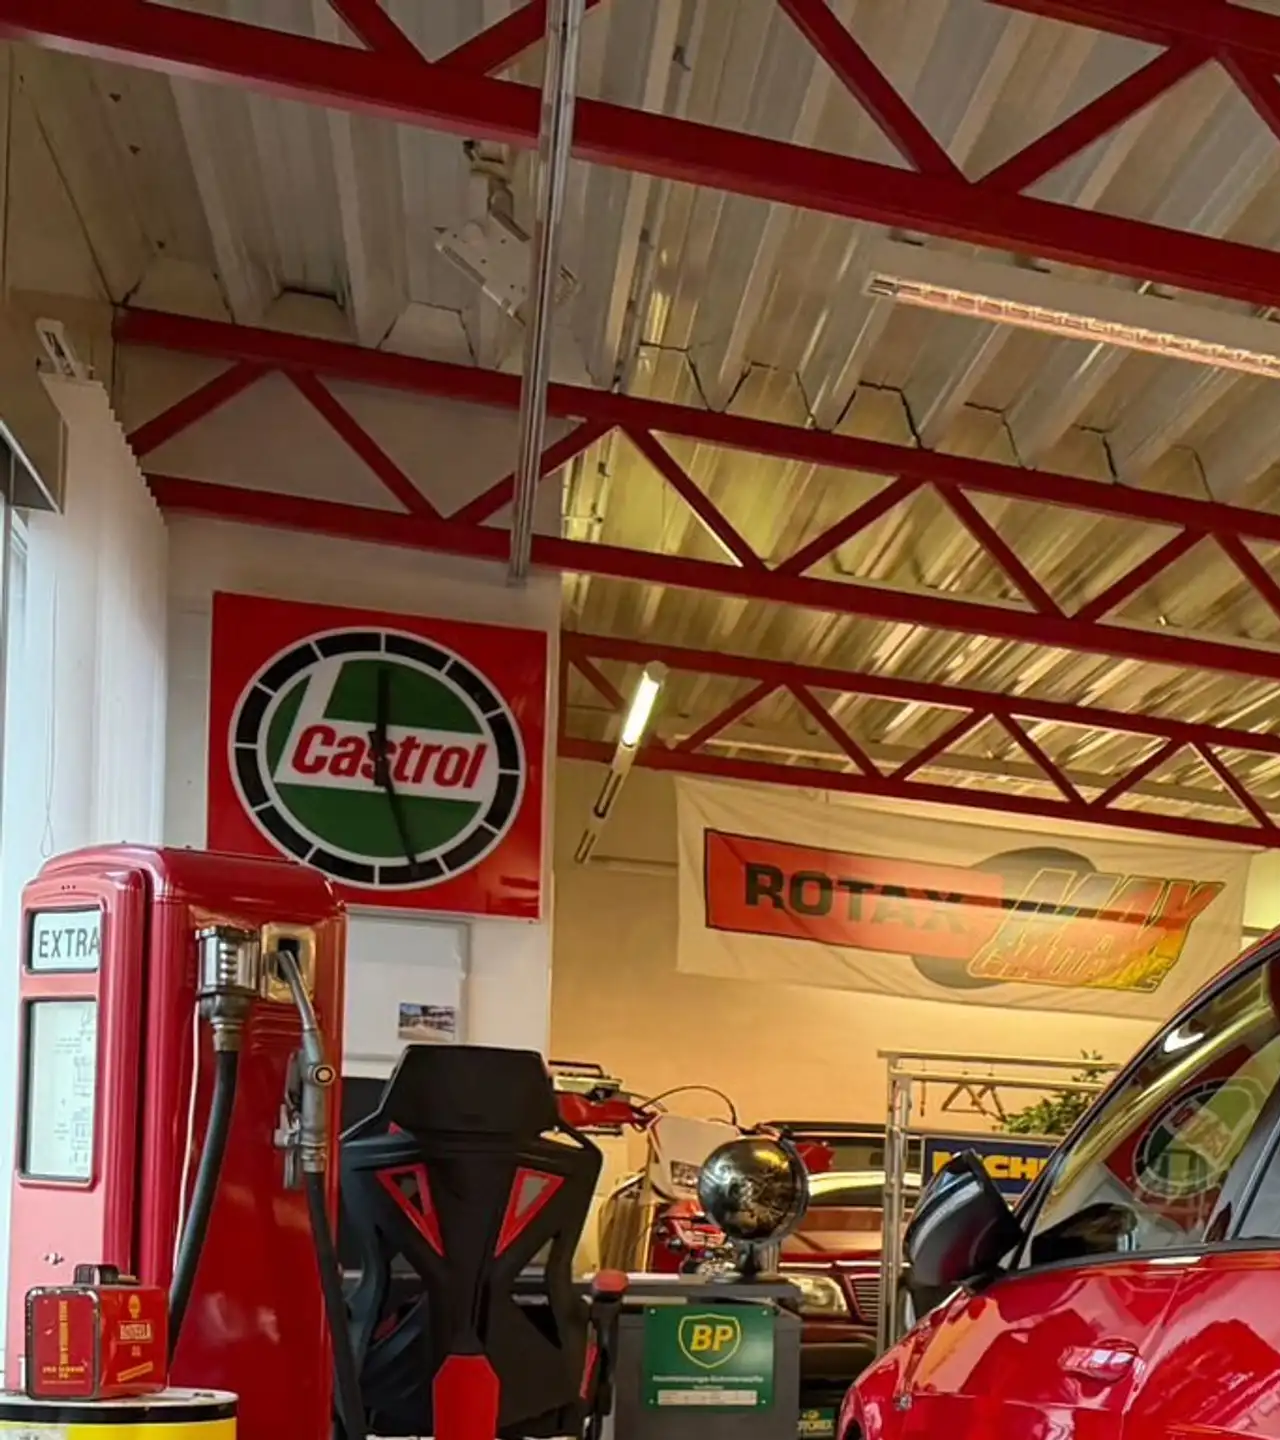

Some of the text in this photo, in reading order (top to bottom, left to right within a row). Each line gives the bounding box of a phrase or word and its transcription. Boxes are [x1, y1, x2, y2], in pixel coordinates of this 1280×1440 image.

[745, 861, 970, 933] ROTAX
[38, 926, 100, 959] EXTRA
[690, 1323, 734, 1352] BP
